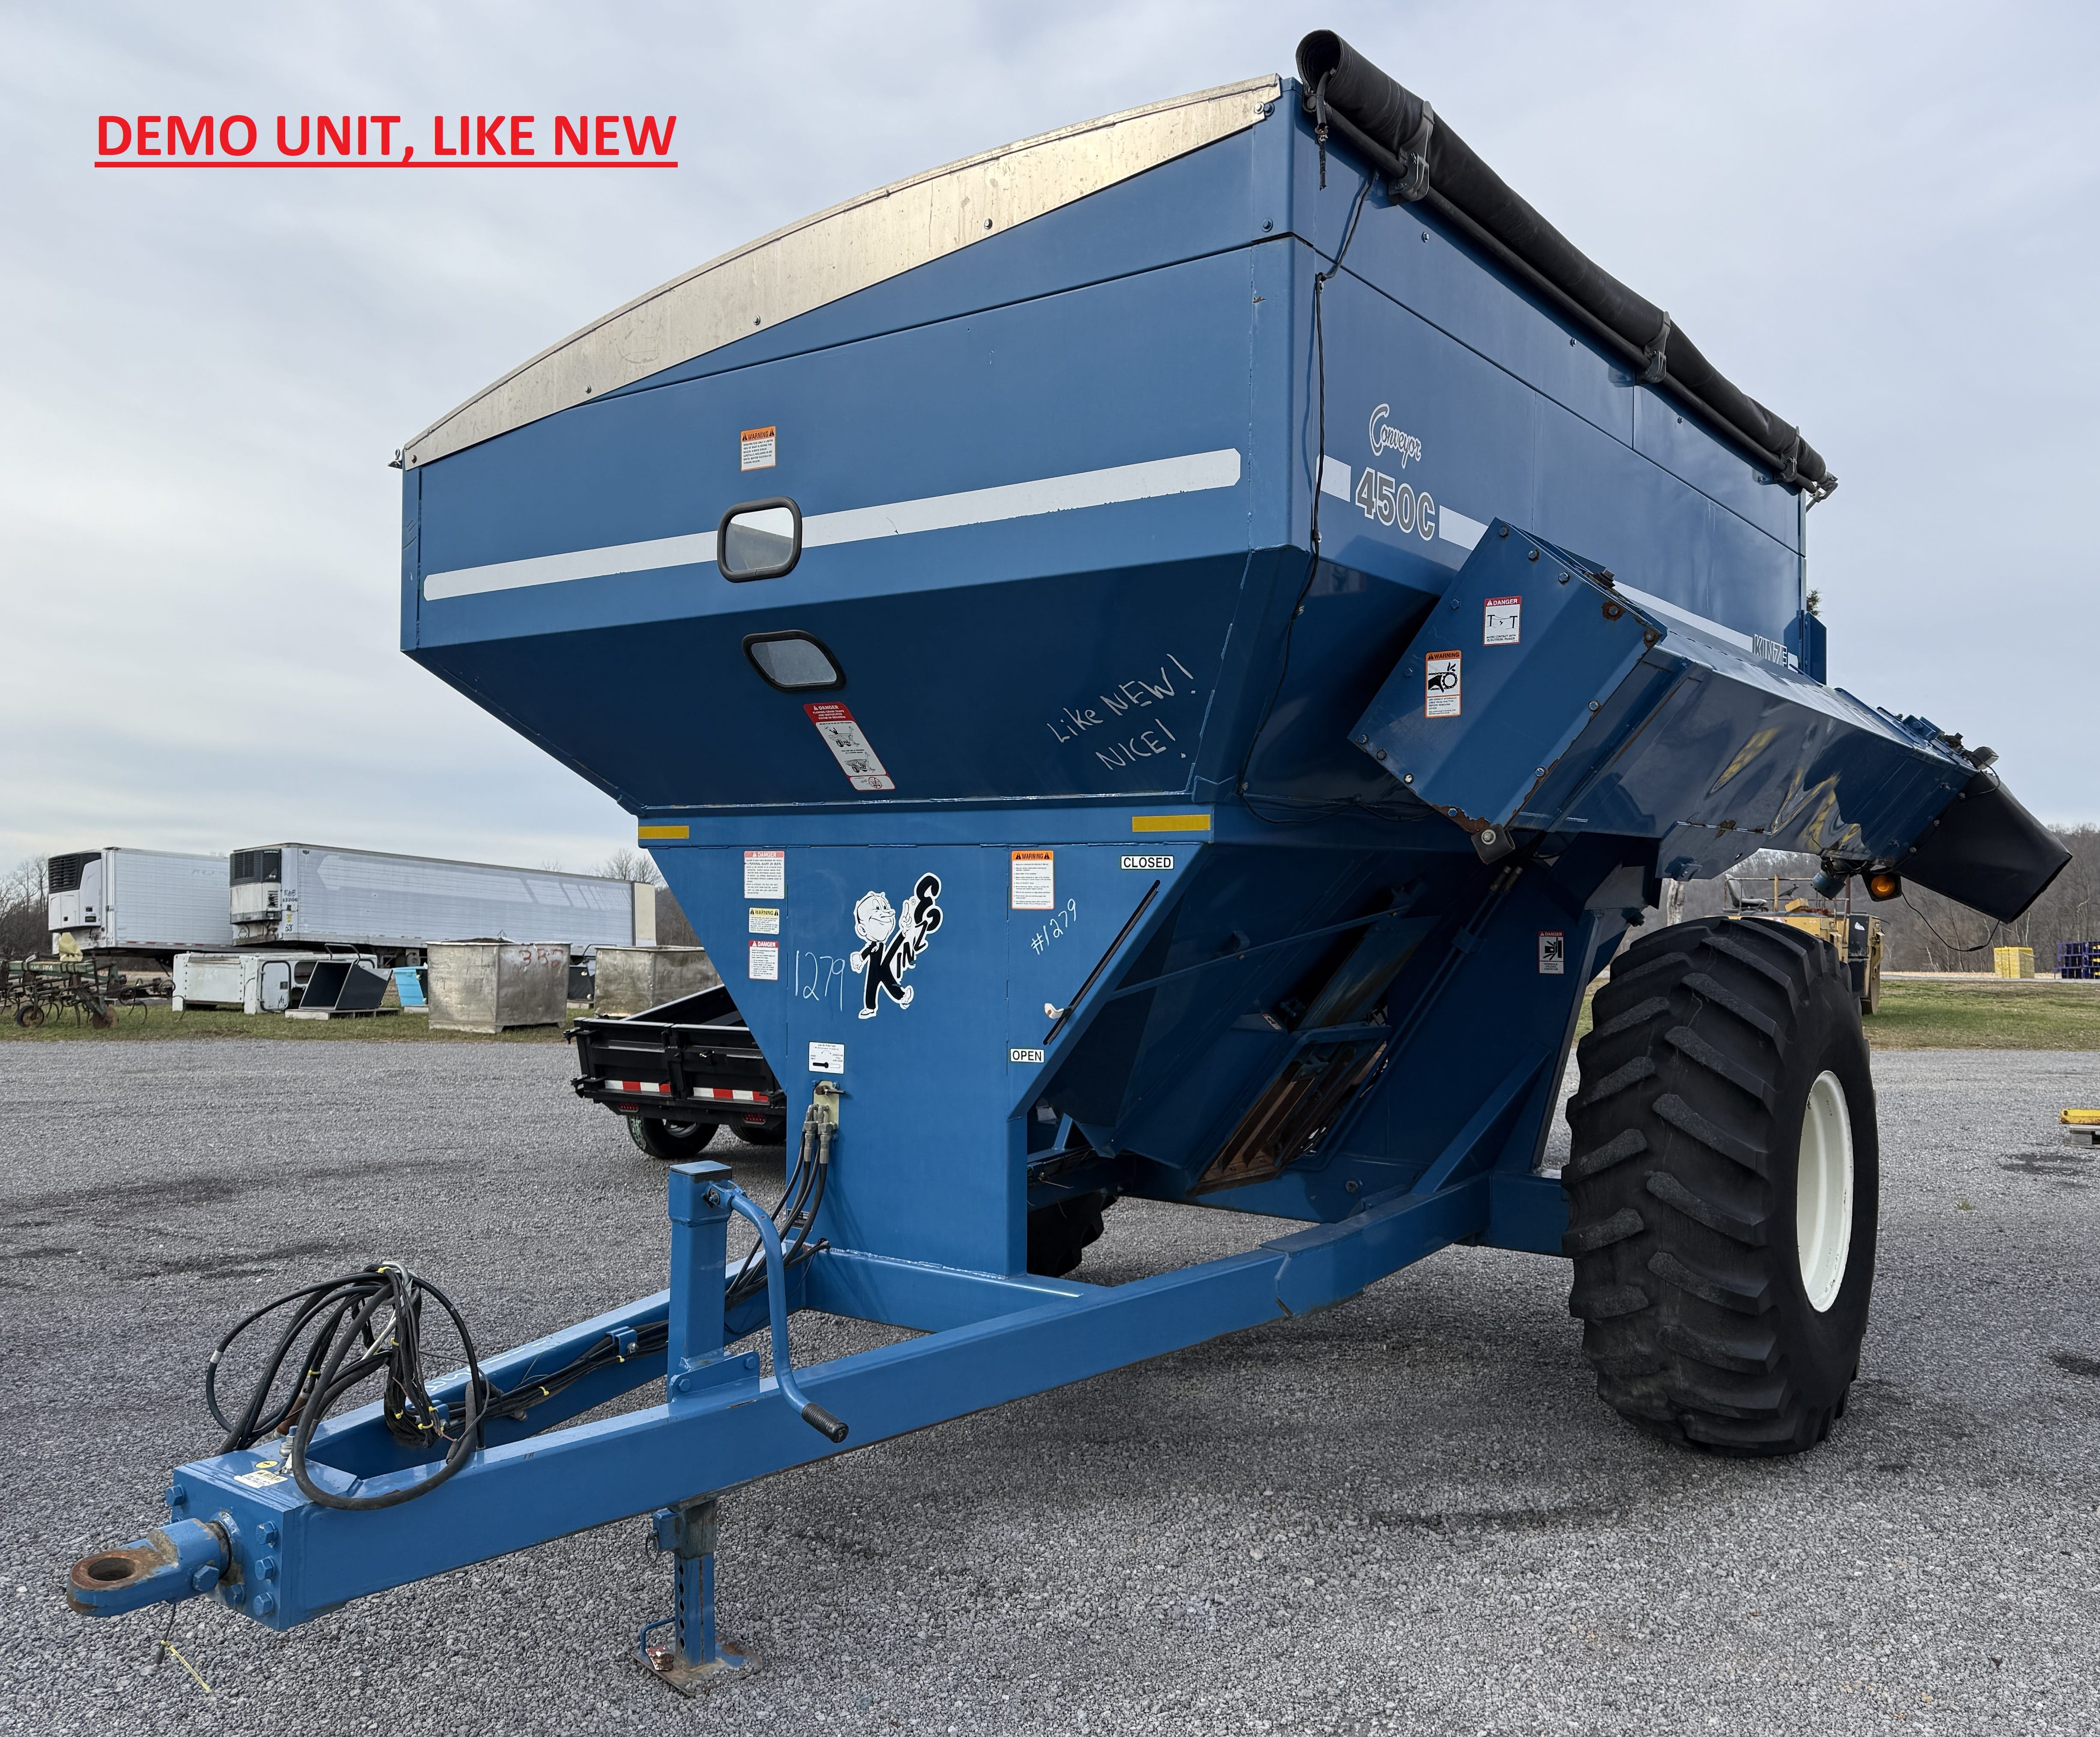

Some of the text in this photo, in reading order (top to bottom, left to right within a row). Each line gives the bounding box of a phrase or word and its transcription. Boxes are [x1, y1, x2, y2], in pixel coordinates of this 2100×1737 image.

[748, 431, 769, 440] WARNING
[1369, 403, 1421, 469] Conveyor
[1355, 467, 1435, 541] 450C
[1754, 634, 1787, 667] KINZE
[1047, 653, 1196, 743] Like NEW!
[1095, 718, 1186, 770] NICE!
[1123, 857, 1171, 868] CLOSED
[1031, 898, 1076, 955] #1279
[795, 950, 845, 1012] 1279
[1013, 1050, 1042, 1061] OPEN
